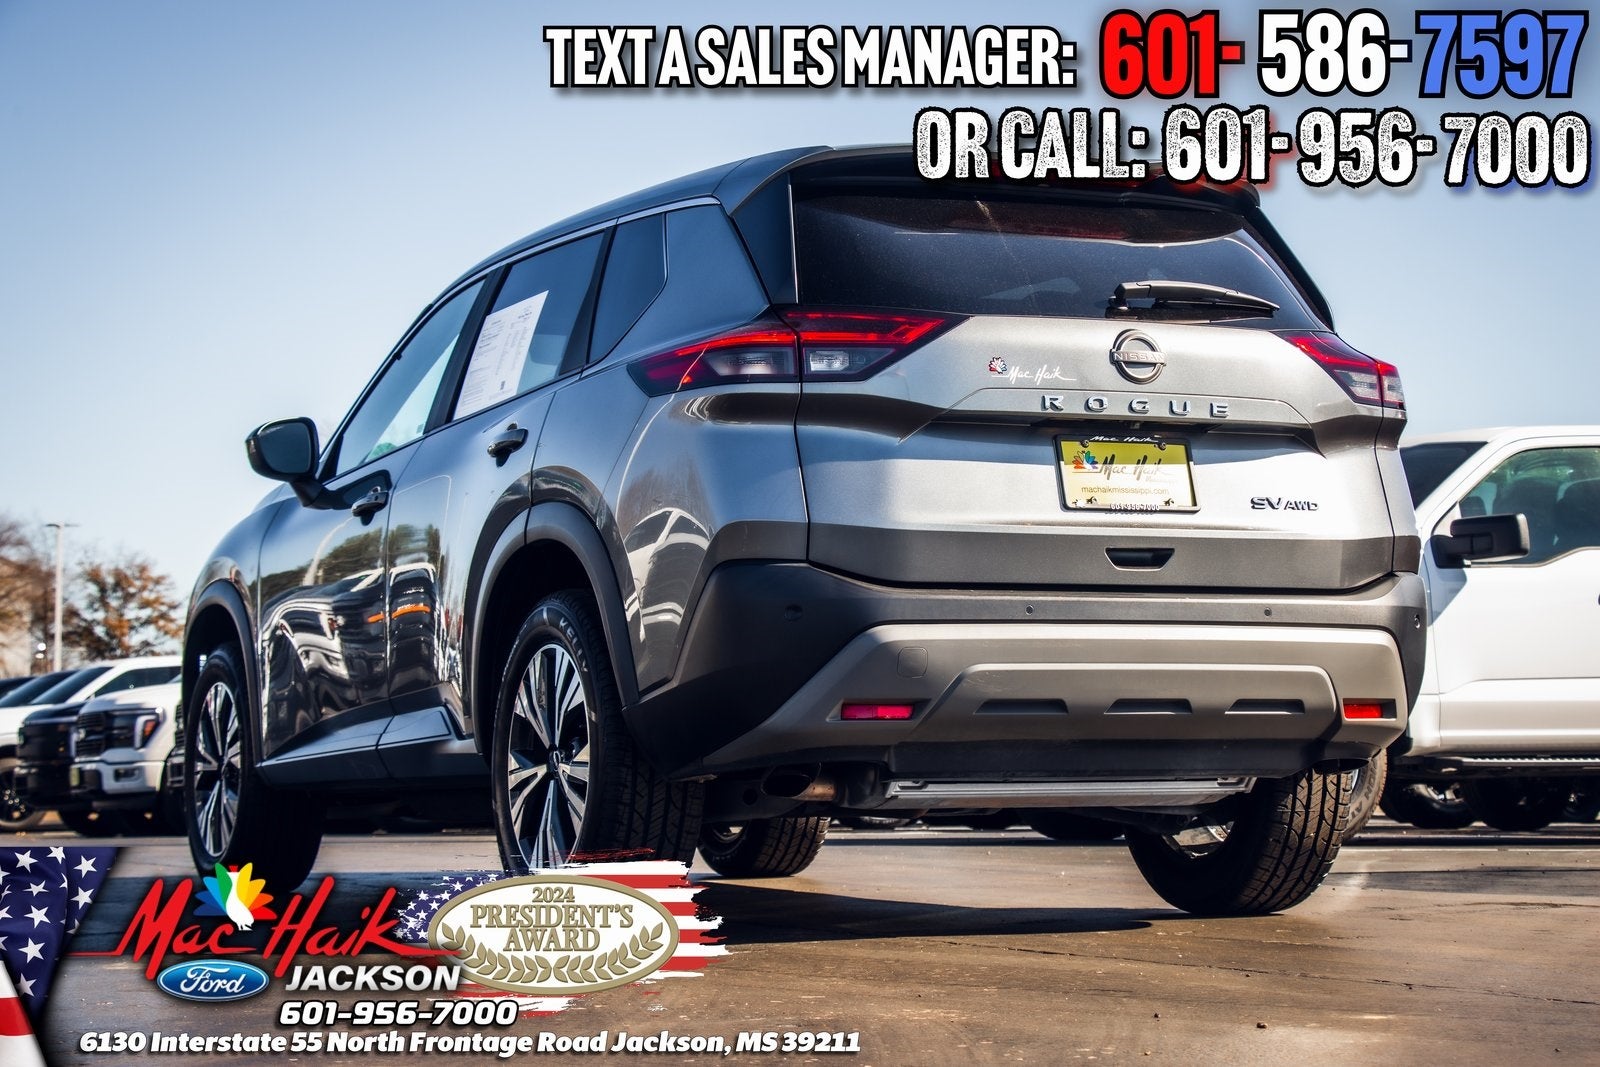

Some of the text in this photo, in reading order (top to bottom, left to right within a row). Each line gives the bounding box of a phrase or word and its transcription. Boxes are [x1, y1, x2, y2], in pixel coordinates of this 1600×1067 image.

[1114, 352, 1165, 363] NISSAN
[1007, 364, 1076, 386] Mac Haik
[1042, 394, 1230, 418] ROGUE
[1099, 454, 1172, 481] Mac Haik
[1081, 485, 1170, 496] machaikmississippi.com
[1251, 496, 1319, 512] SV AWD
[559, 617, 588, 672] KELLY
